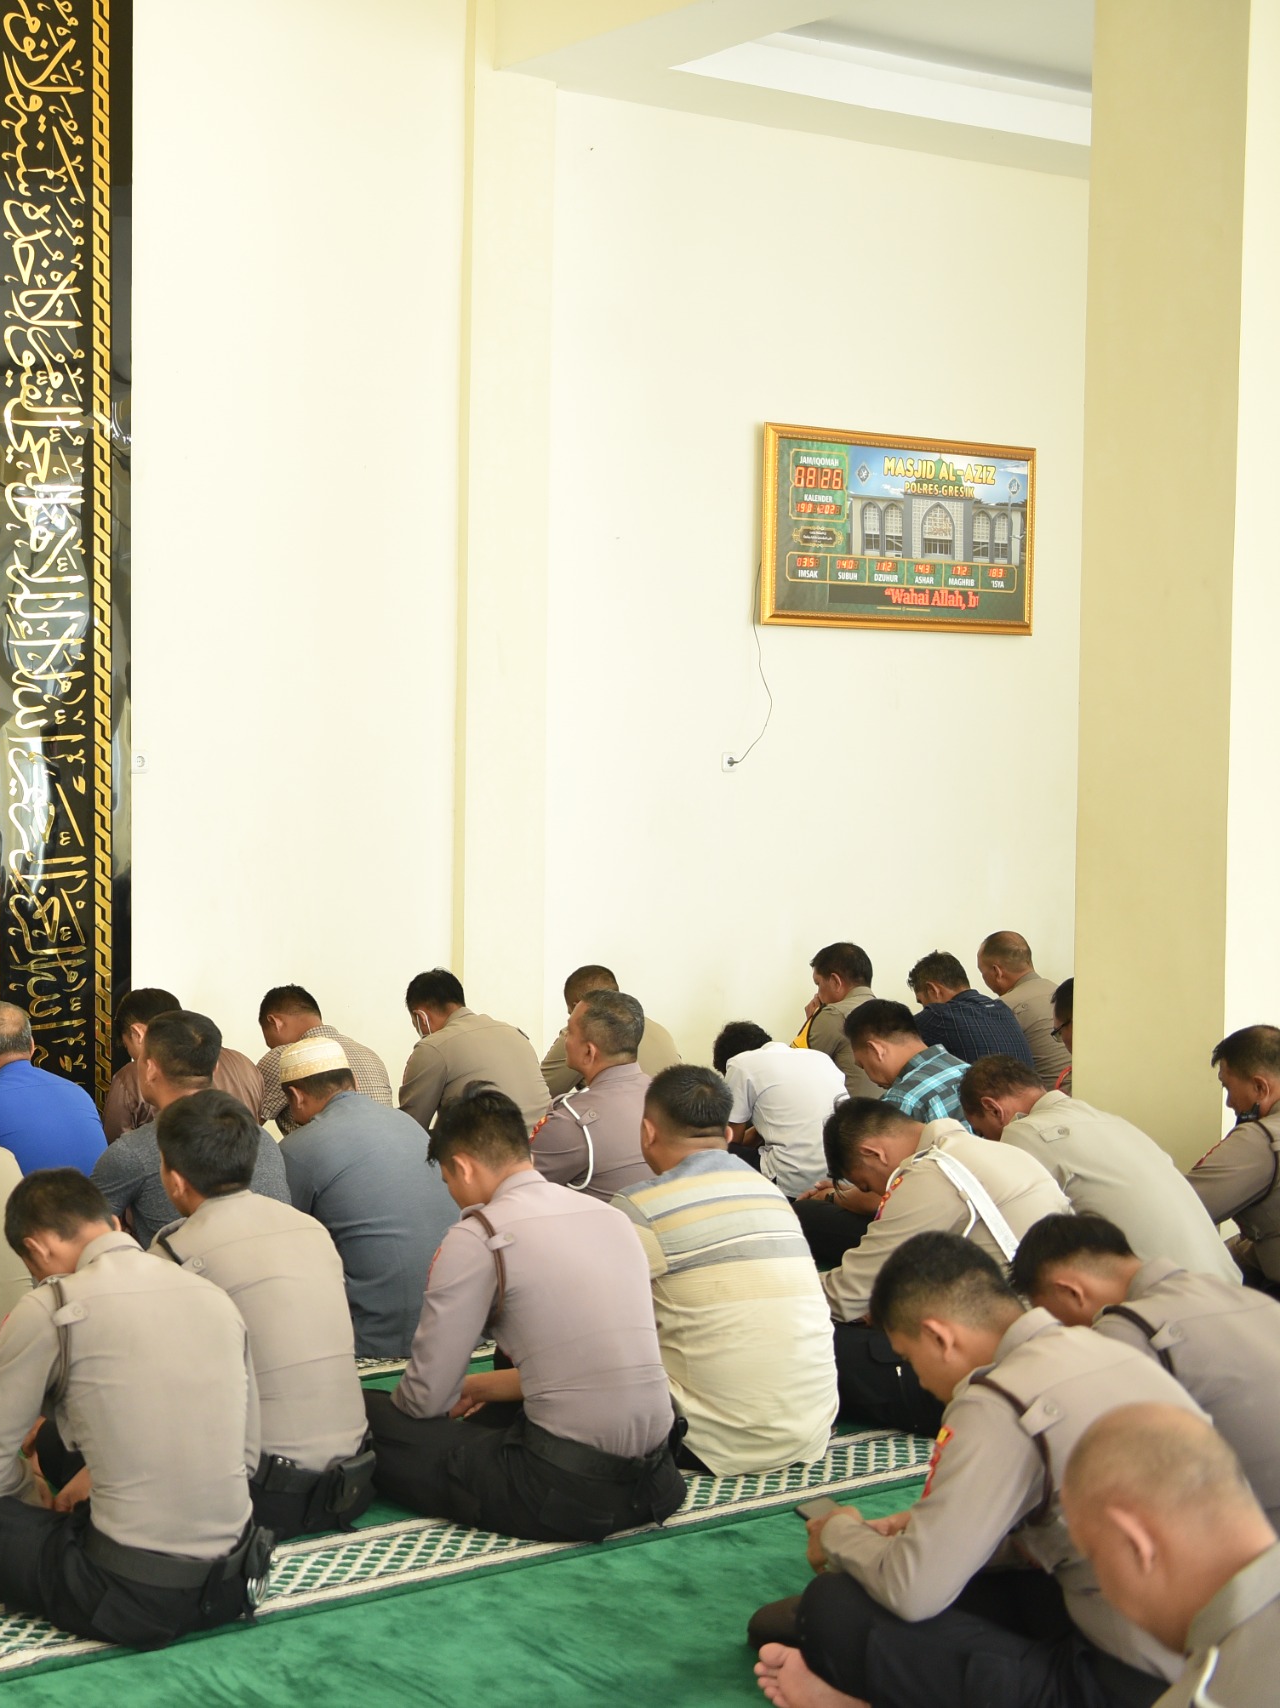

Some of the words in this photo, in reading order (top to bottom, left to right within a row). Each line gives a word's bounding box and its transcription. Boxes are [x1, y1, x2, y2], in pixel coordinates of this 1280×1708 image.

[883, 456, 936, 480] MASJID
[938, 462, 997, 485] AL-AZIZ
[904, 481, 939, 495] POLRES
[941, 484, 975, 499] GRESIK
[804, 494, 833, 503] KALENDER
[798, 569, 819, 578] IMSAK
[838, 572, 858, 580] SUBUH
[874, 573, 898, 582] DZUHUR
[914, 576, 934, 584] ASHAR
[948, 577, 975, 587] MAGHRIB
[931, 589, 966, 610] Allah,
